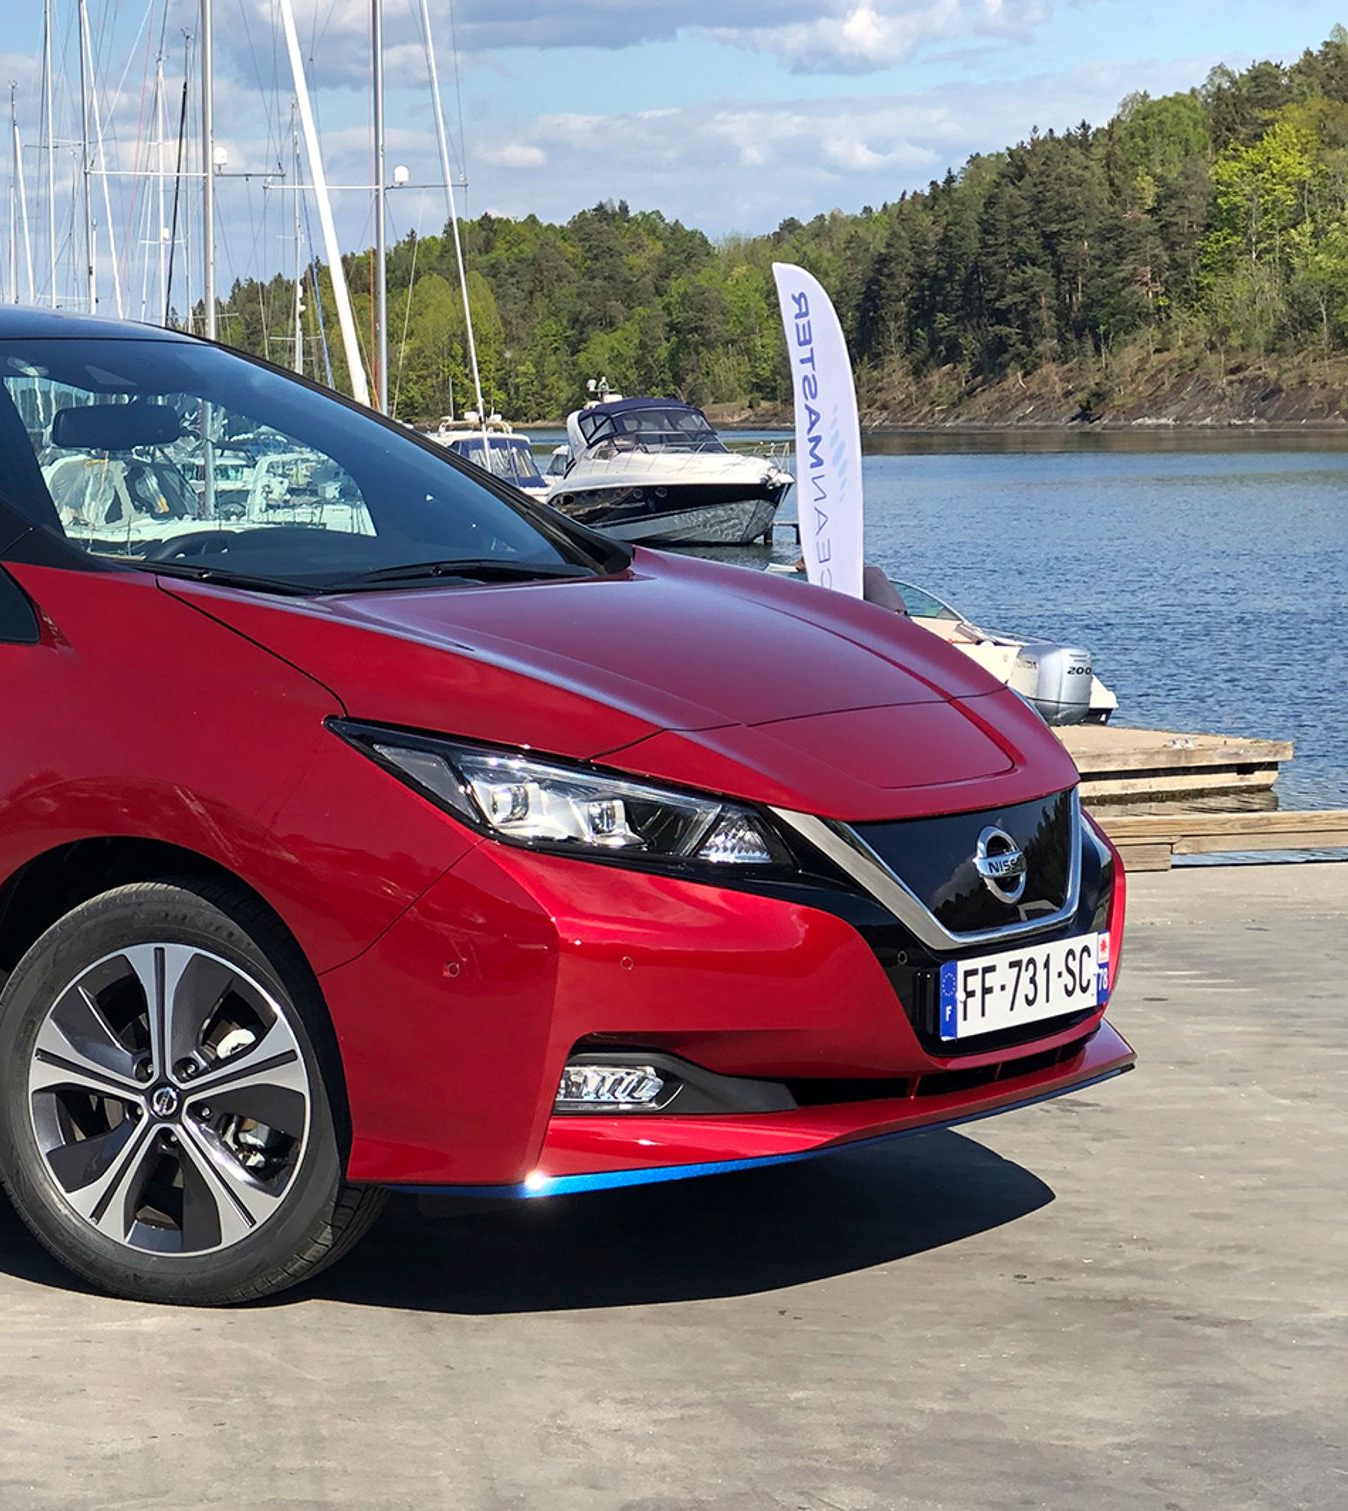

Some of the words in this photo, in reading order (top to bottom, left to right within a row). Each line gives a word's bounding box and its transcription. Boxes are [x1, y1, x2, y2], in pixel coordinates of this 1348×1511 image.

[1067, 667, 1092, 675] 200
[988, 857, 1025, 873] NISS
[963, 945, 1092, 1021] FF-731-SC
[946, 1005, 953, 1021] F
